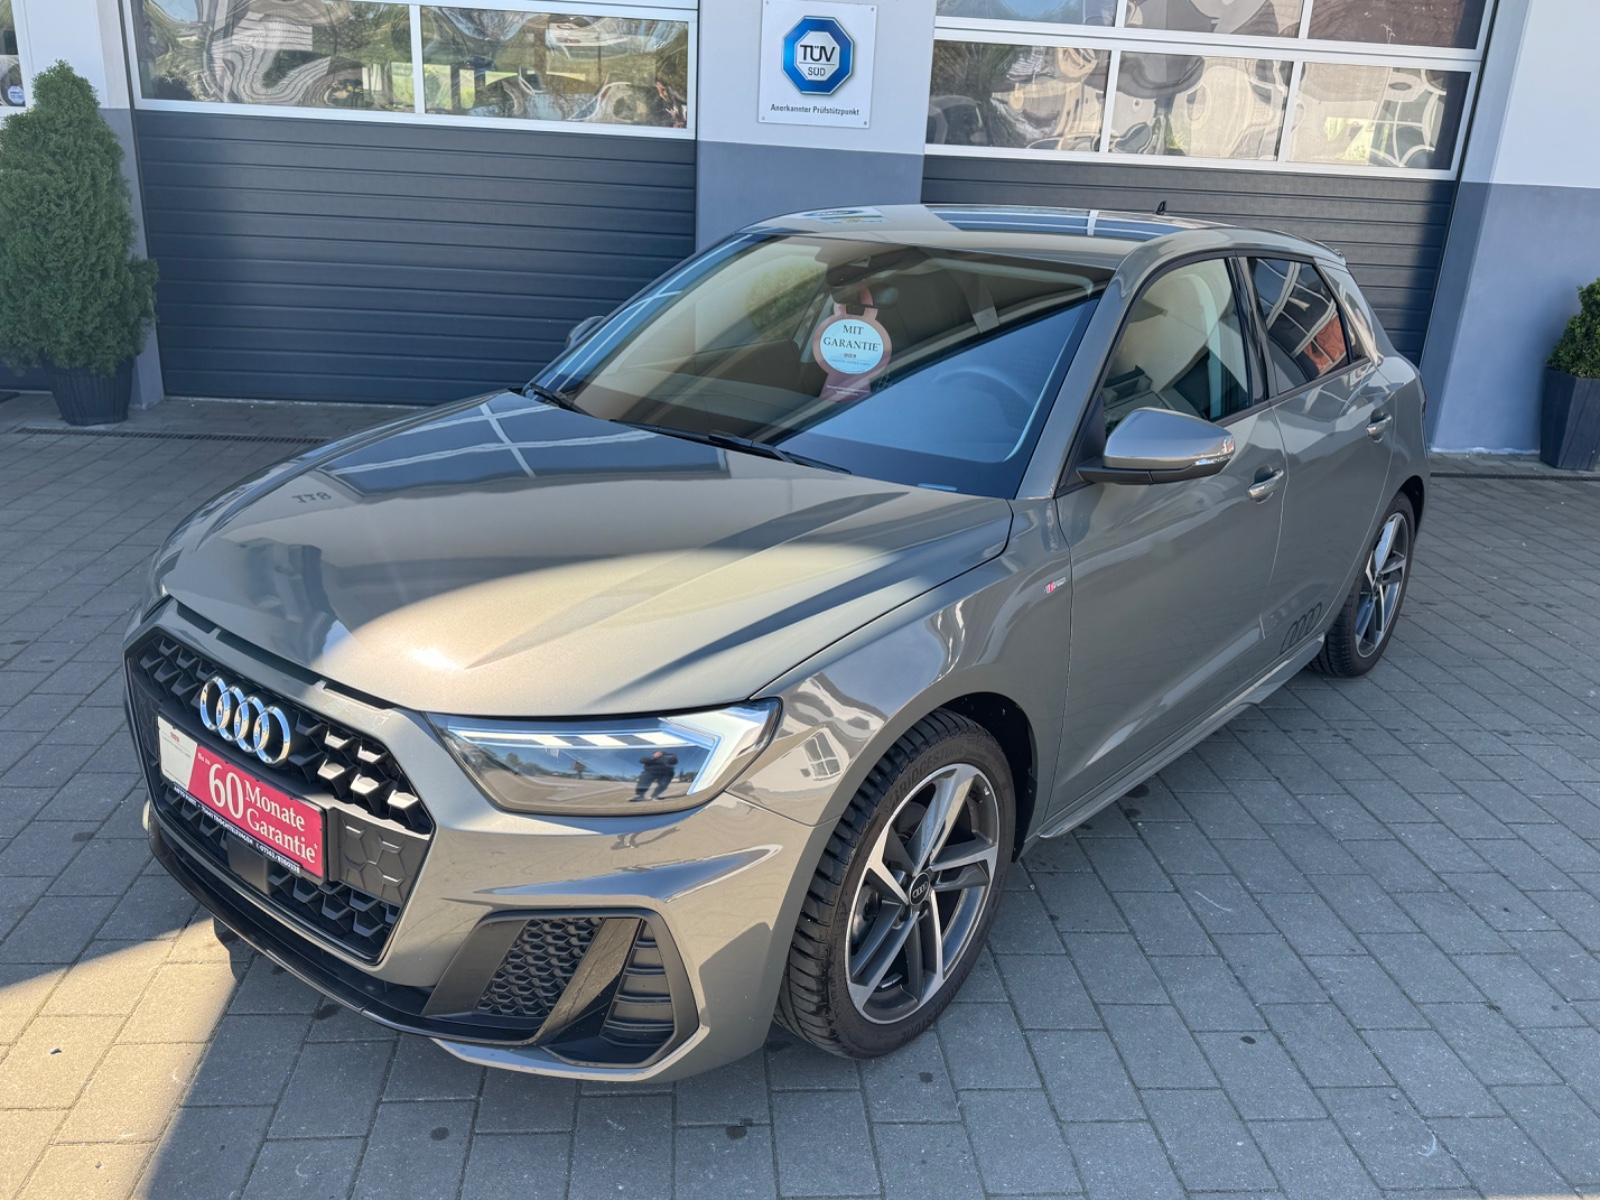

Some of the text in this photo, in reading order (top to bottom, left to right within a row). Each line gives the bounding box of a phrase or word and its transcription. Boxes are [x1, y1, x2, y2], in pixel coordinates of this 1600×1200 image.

[799, 44, 836, 62] TÜV
[807, 66, 826, 77] SÜD
[770, 103, 860, 117] Anerkannter Prüfstützpunkt
[843, 324, 865, 336] MIT
[823, 336, 881, 352] GARANTIE
[208, 763, 245, 820] 60
[244, 779, 306, 832] Monate
